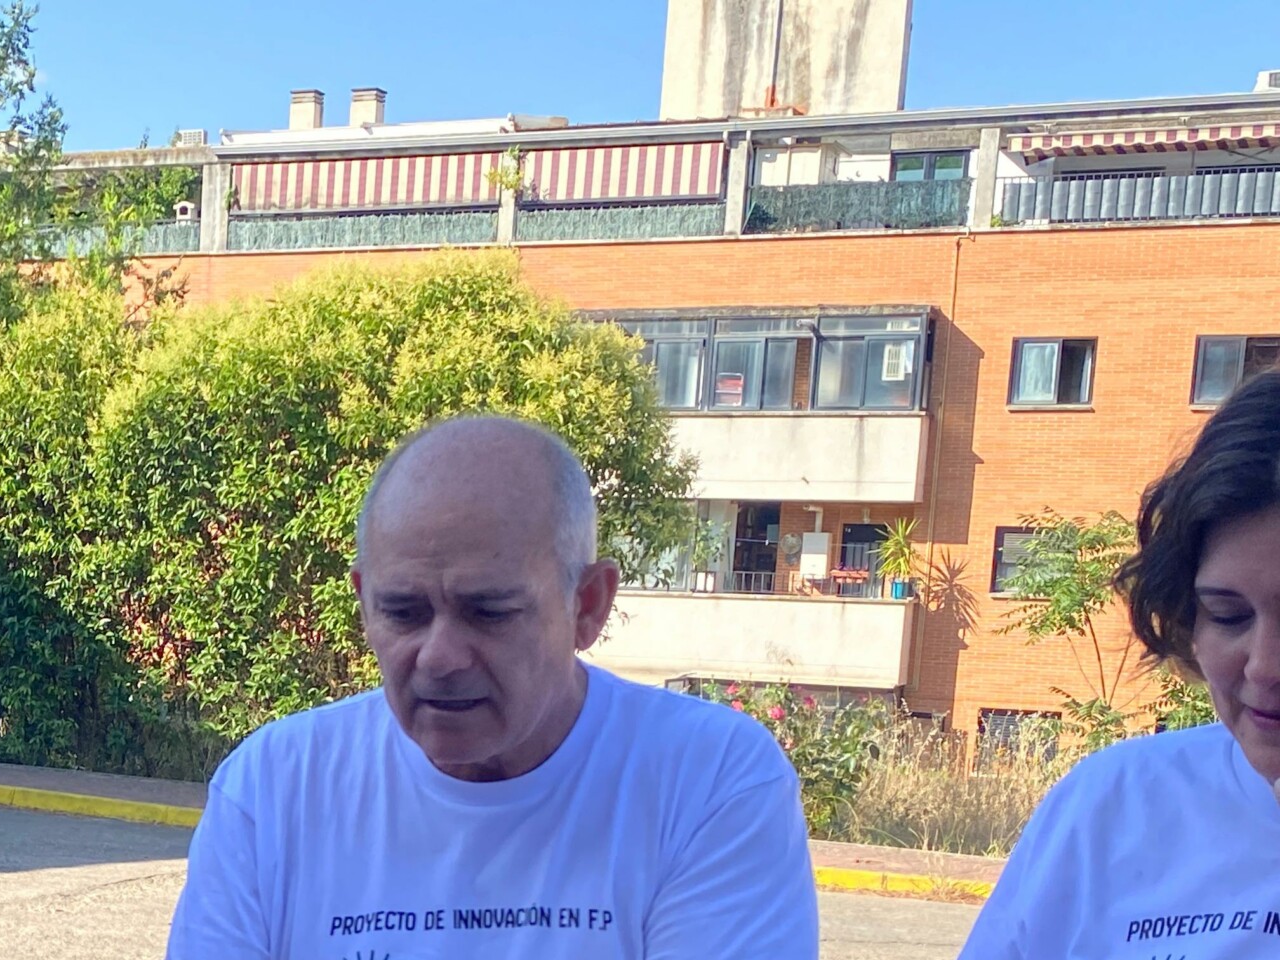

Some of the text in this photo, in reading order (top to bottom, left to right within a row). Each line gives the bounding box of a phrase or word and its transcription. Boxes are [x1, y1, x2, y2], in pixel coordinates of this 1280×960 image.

[330, 911, 417, 936] PROYECTO
[424, 910, 445, 930] DE
[453, 903, 552, 930] INNOVACIÓN
[559, 908, 580, 928] EN
[1127, 912, 1224, 942] PROYECTO
[1229, 910, 1258, 930] DE
